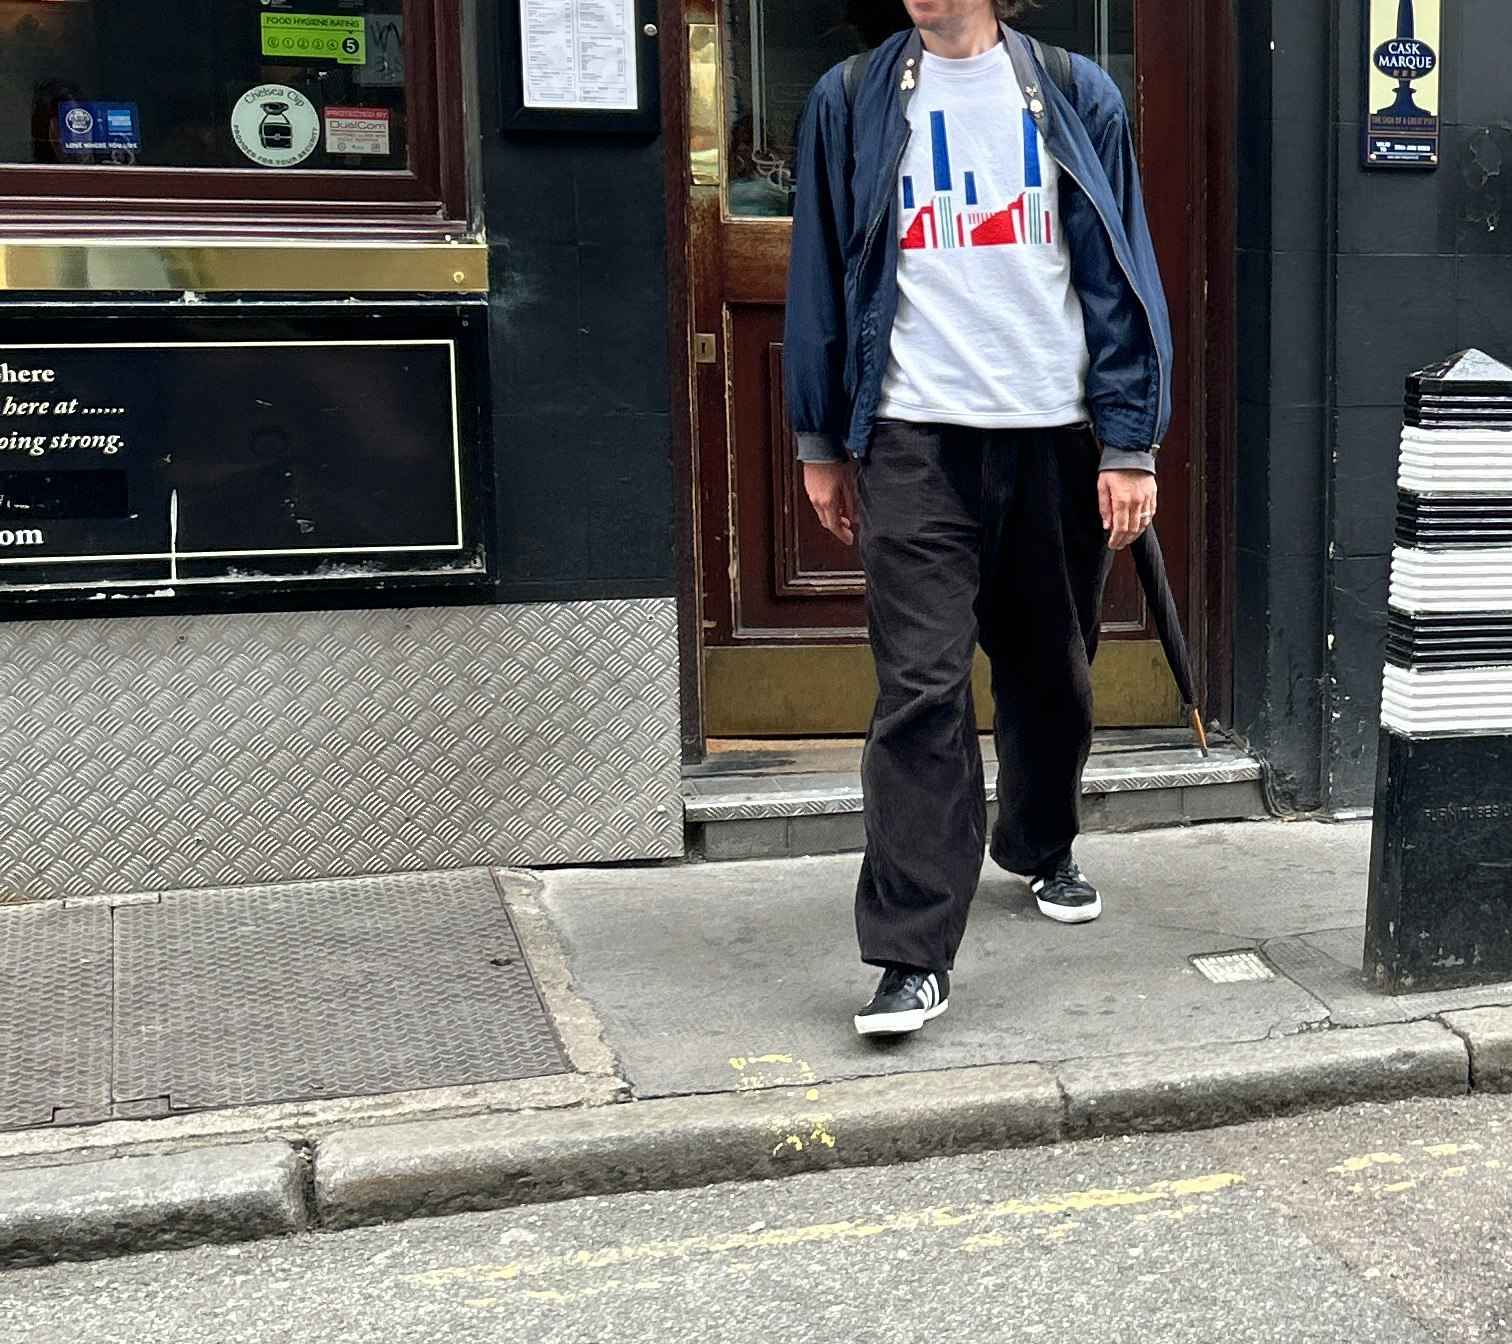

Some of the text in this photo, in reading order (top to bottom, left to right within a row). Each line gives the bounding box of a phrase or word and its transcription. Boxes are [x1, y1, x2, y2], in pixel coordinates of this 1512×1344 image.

[266, 16, 360, 28] FOOD HYGIENE RATING
[1388, 42, 1421, 55] CASK
[1378, 55, 1433, 69] MARQUE
[0, 363, 55, 383] here
[3, 396, 48, 415] here
[53, 398, 79, 414] at
[49, 433, 124, 454] strong.
